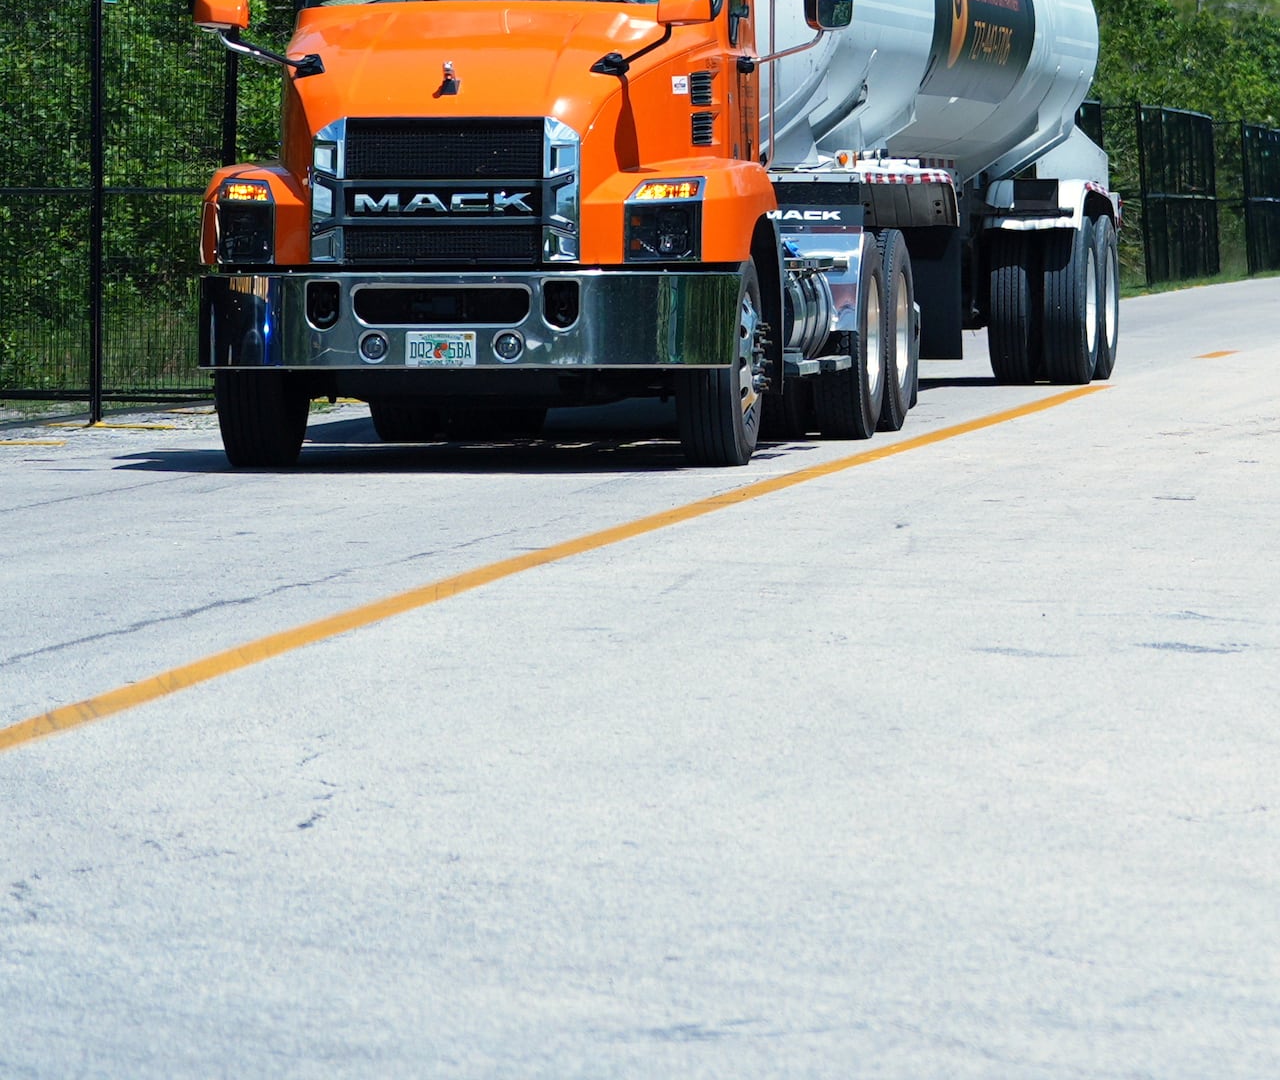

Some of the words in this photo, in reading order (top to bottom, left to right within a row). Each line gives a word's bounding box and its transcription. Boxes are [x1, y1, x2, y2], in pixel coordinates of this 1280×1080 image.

[353, 191, 534, 213] MACK
[766, 209, 842, 221] MACK
[410, 342, 433, 359] DQ2
